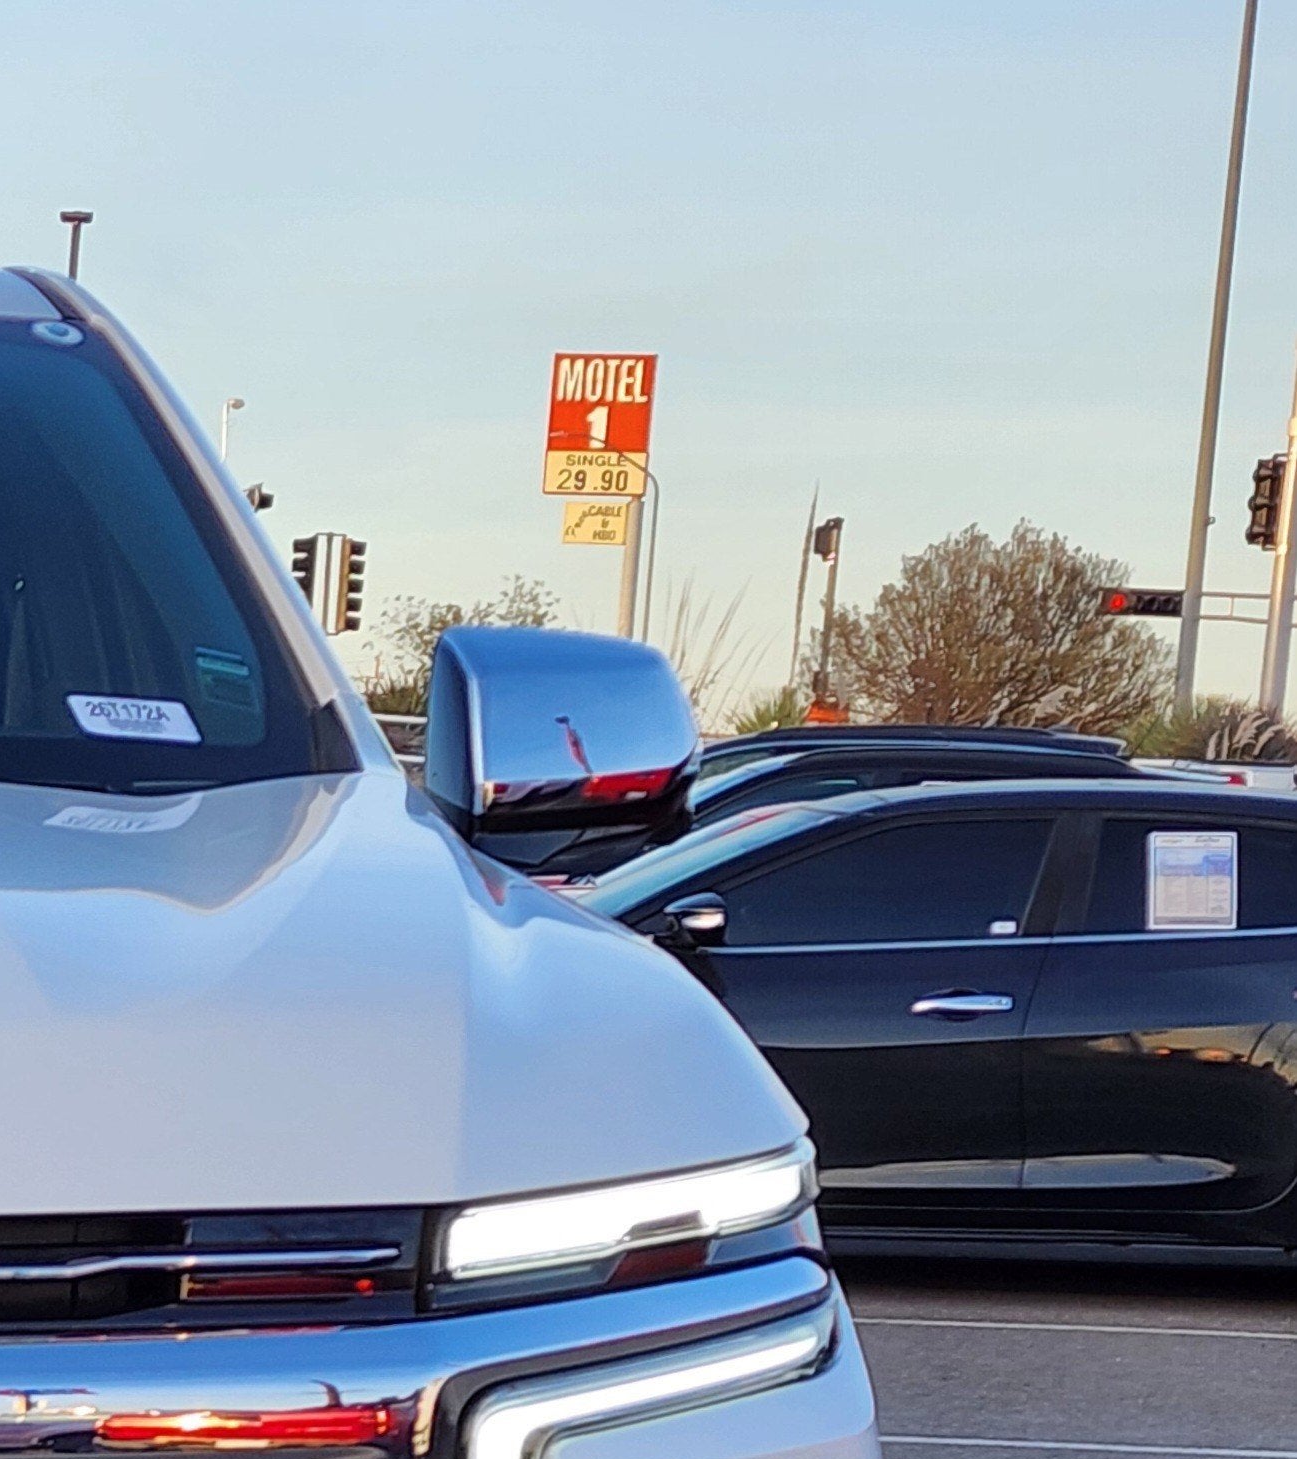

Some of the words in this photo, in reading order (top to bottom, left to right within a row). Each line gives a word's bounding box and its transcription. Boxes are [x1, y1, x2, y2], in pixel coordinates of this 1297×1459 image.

[556, 357, 649, 404] MOTEL
[586, 404, 610, 450] 1
[565, 453, 628, 467] SINGLE
